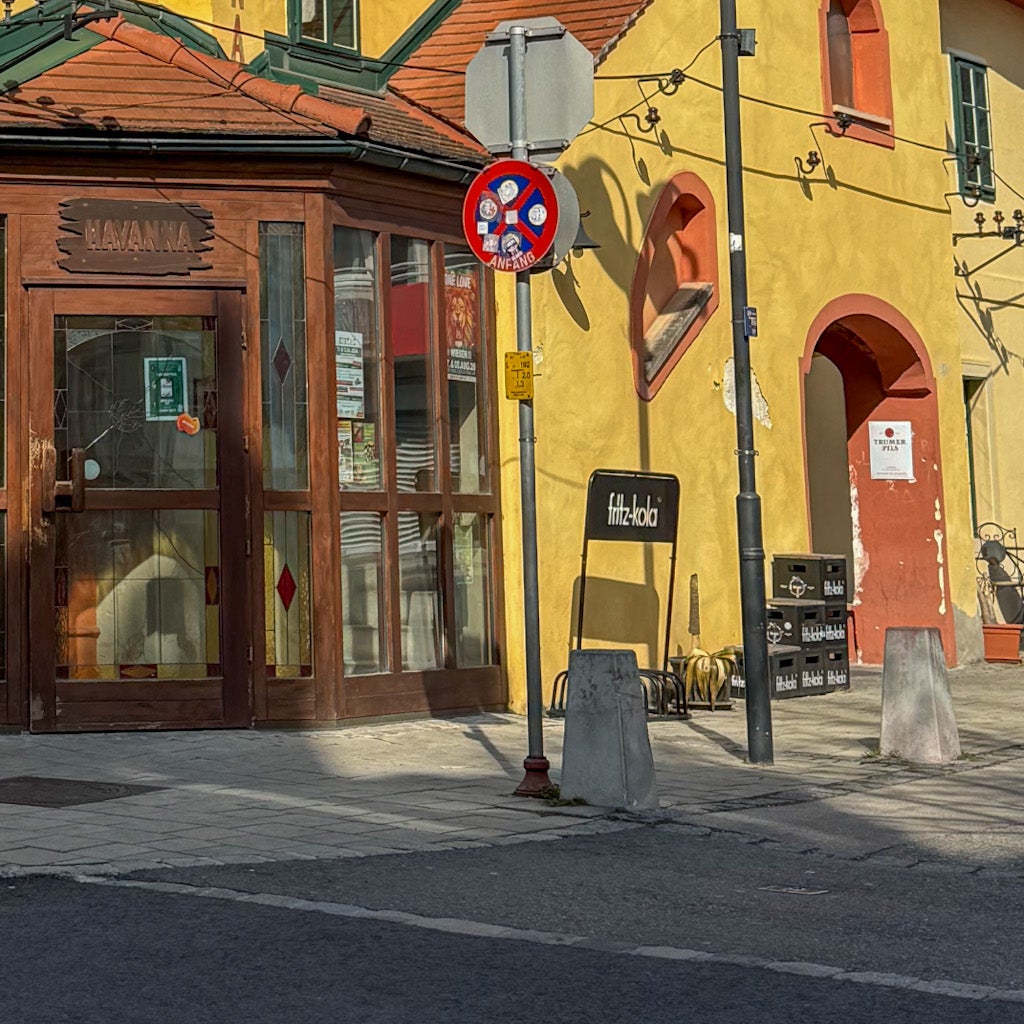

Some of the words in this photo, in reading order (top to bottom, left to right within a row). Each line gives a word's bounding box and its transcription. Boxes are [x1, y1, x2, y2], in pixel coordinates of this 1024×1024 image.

[84, 219, 194, 252] HAVANNA
[490, 251, 535, 270] ANFANG
[607, 492, 658, 527] fritz-kola
